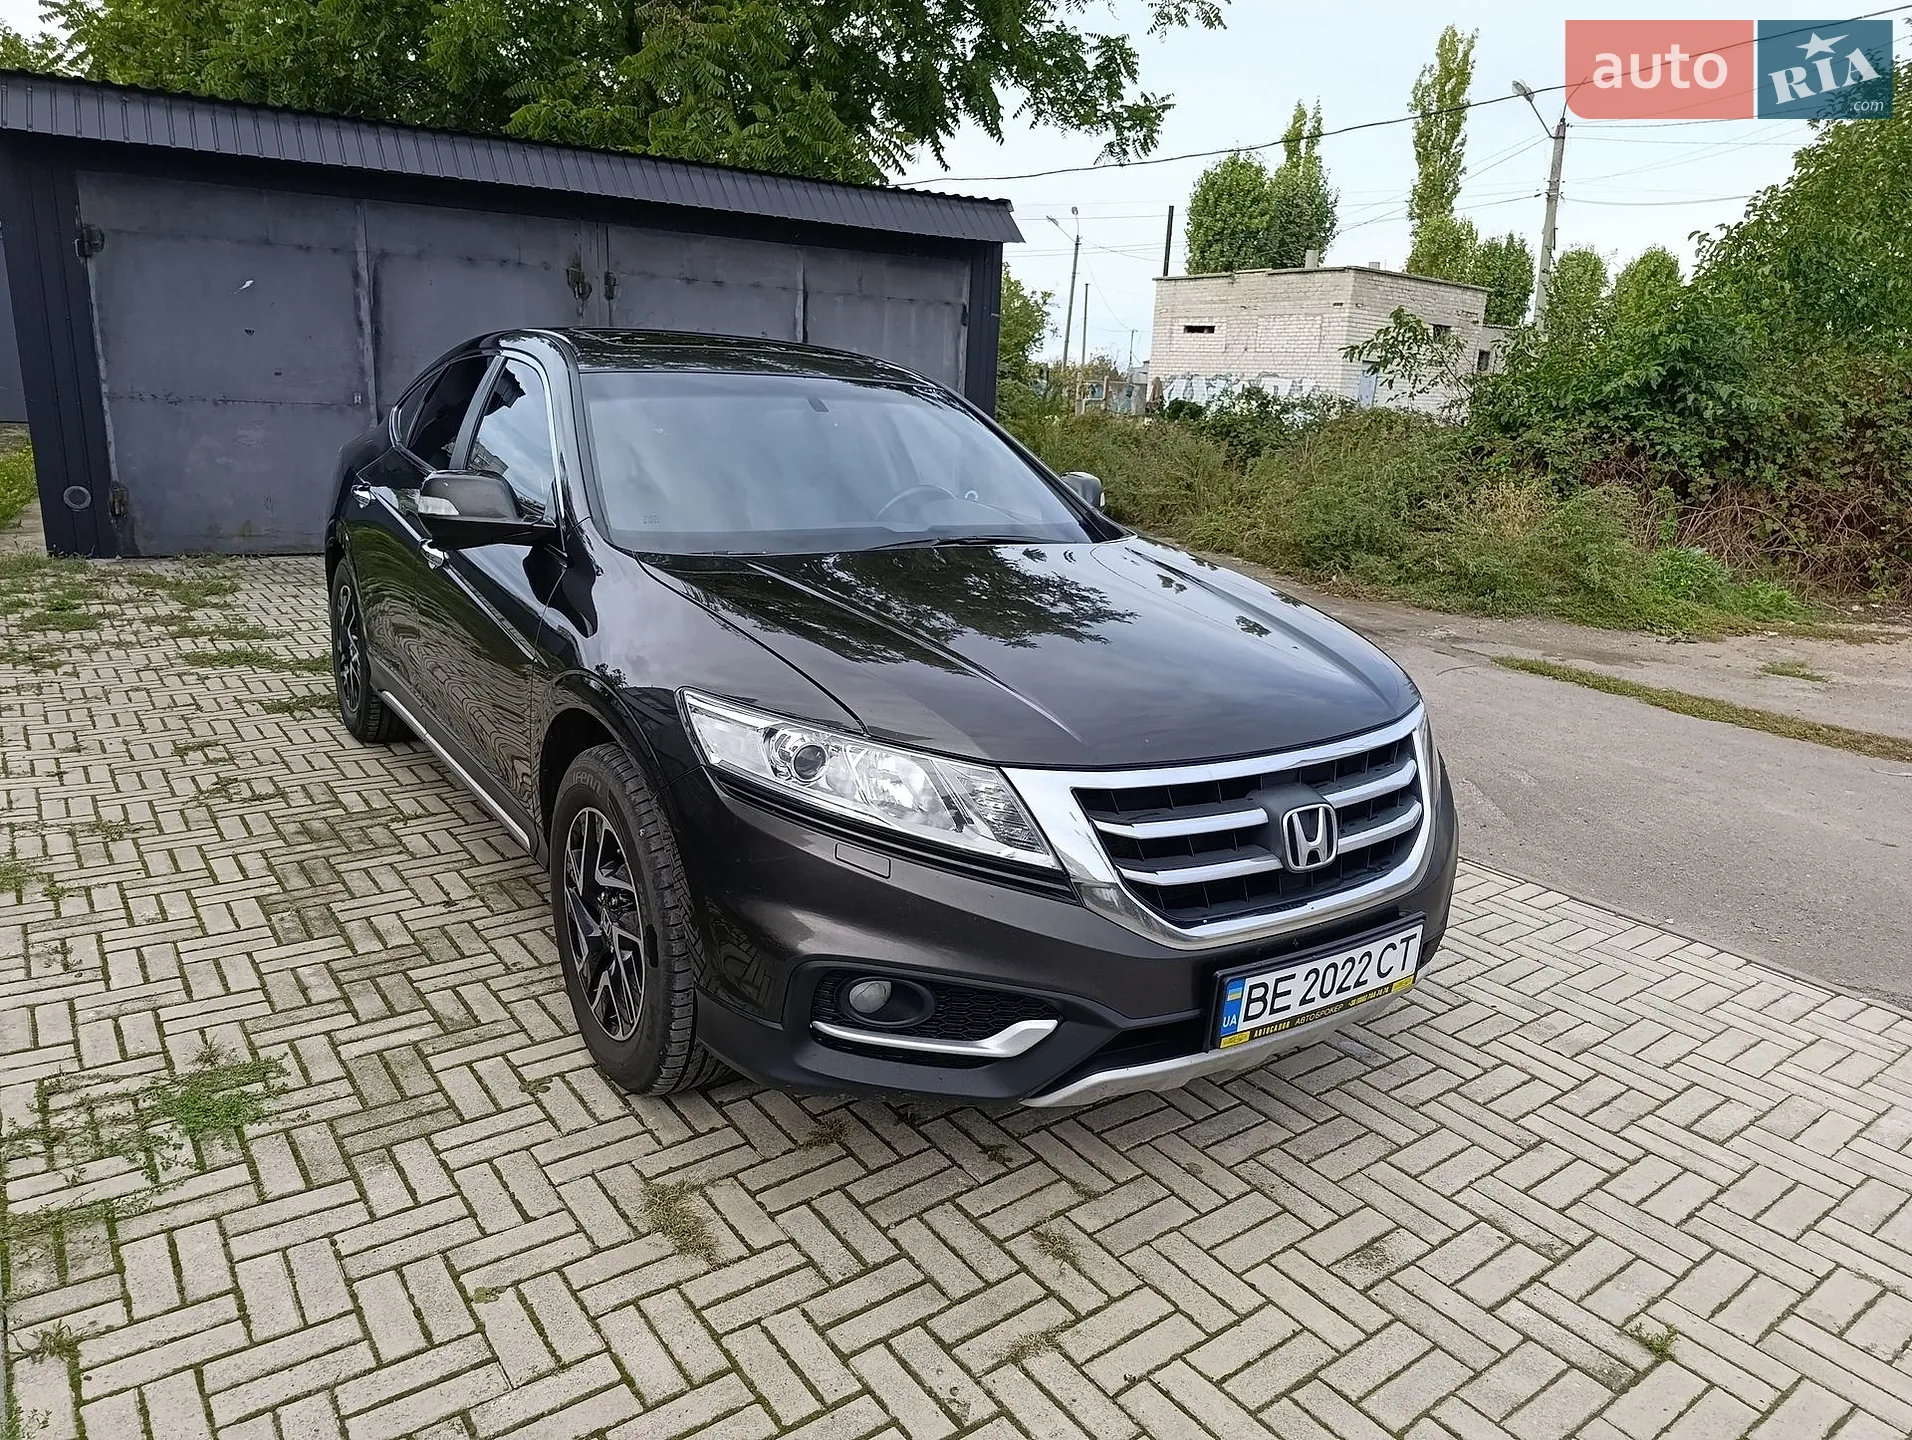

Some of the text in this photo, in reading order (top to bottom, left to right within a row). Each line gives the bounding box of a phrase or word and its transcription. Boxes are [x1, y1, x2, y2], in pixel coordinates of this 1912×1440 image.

[1243, 973, 1297, 1023] BE
[1299, 951, 1373, 1007] 2022
[1376, 934, 1418, 978] CT
[1222, 1014, 1238, 1028] UA
[1294, 1003, 1344, 1026] АВТОБРОКЕР
